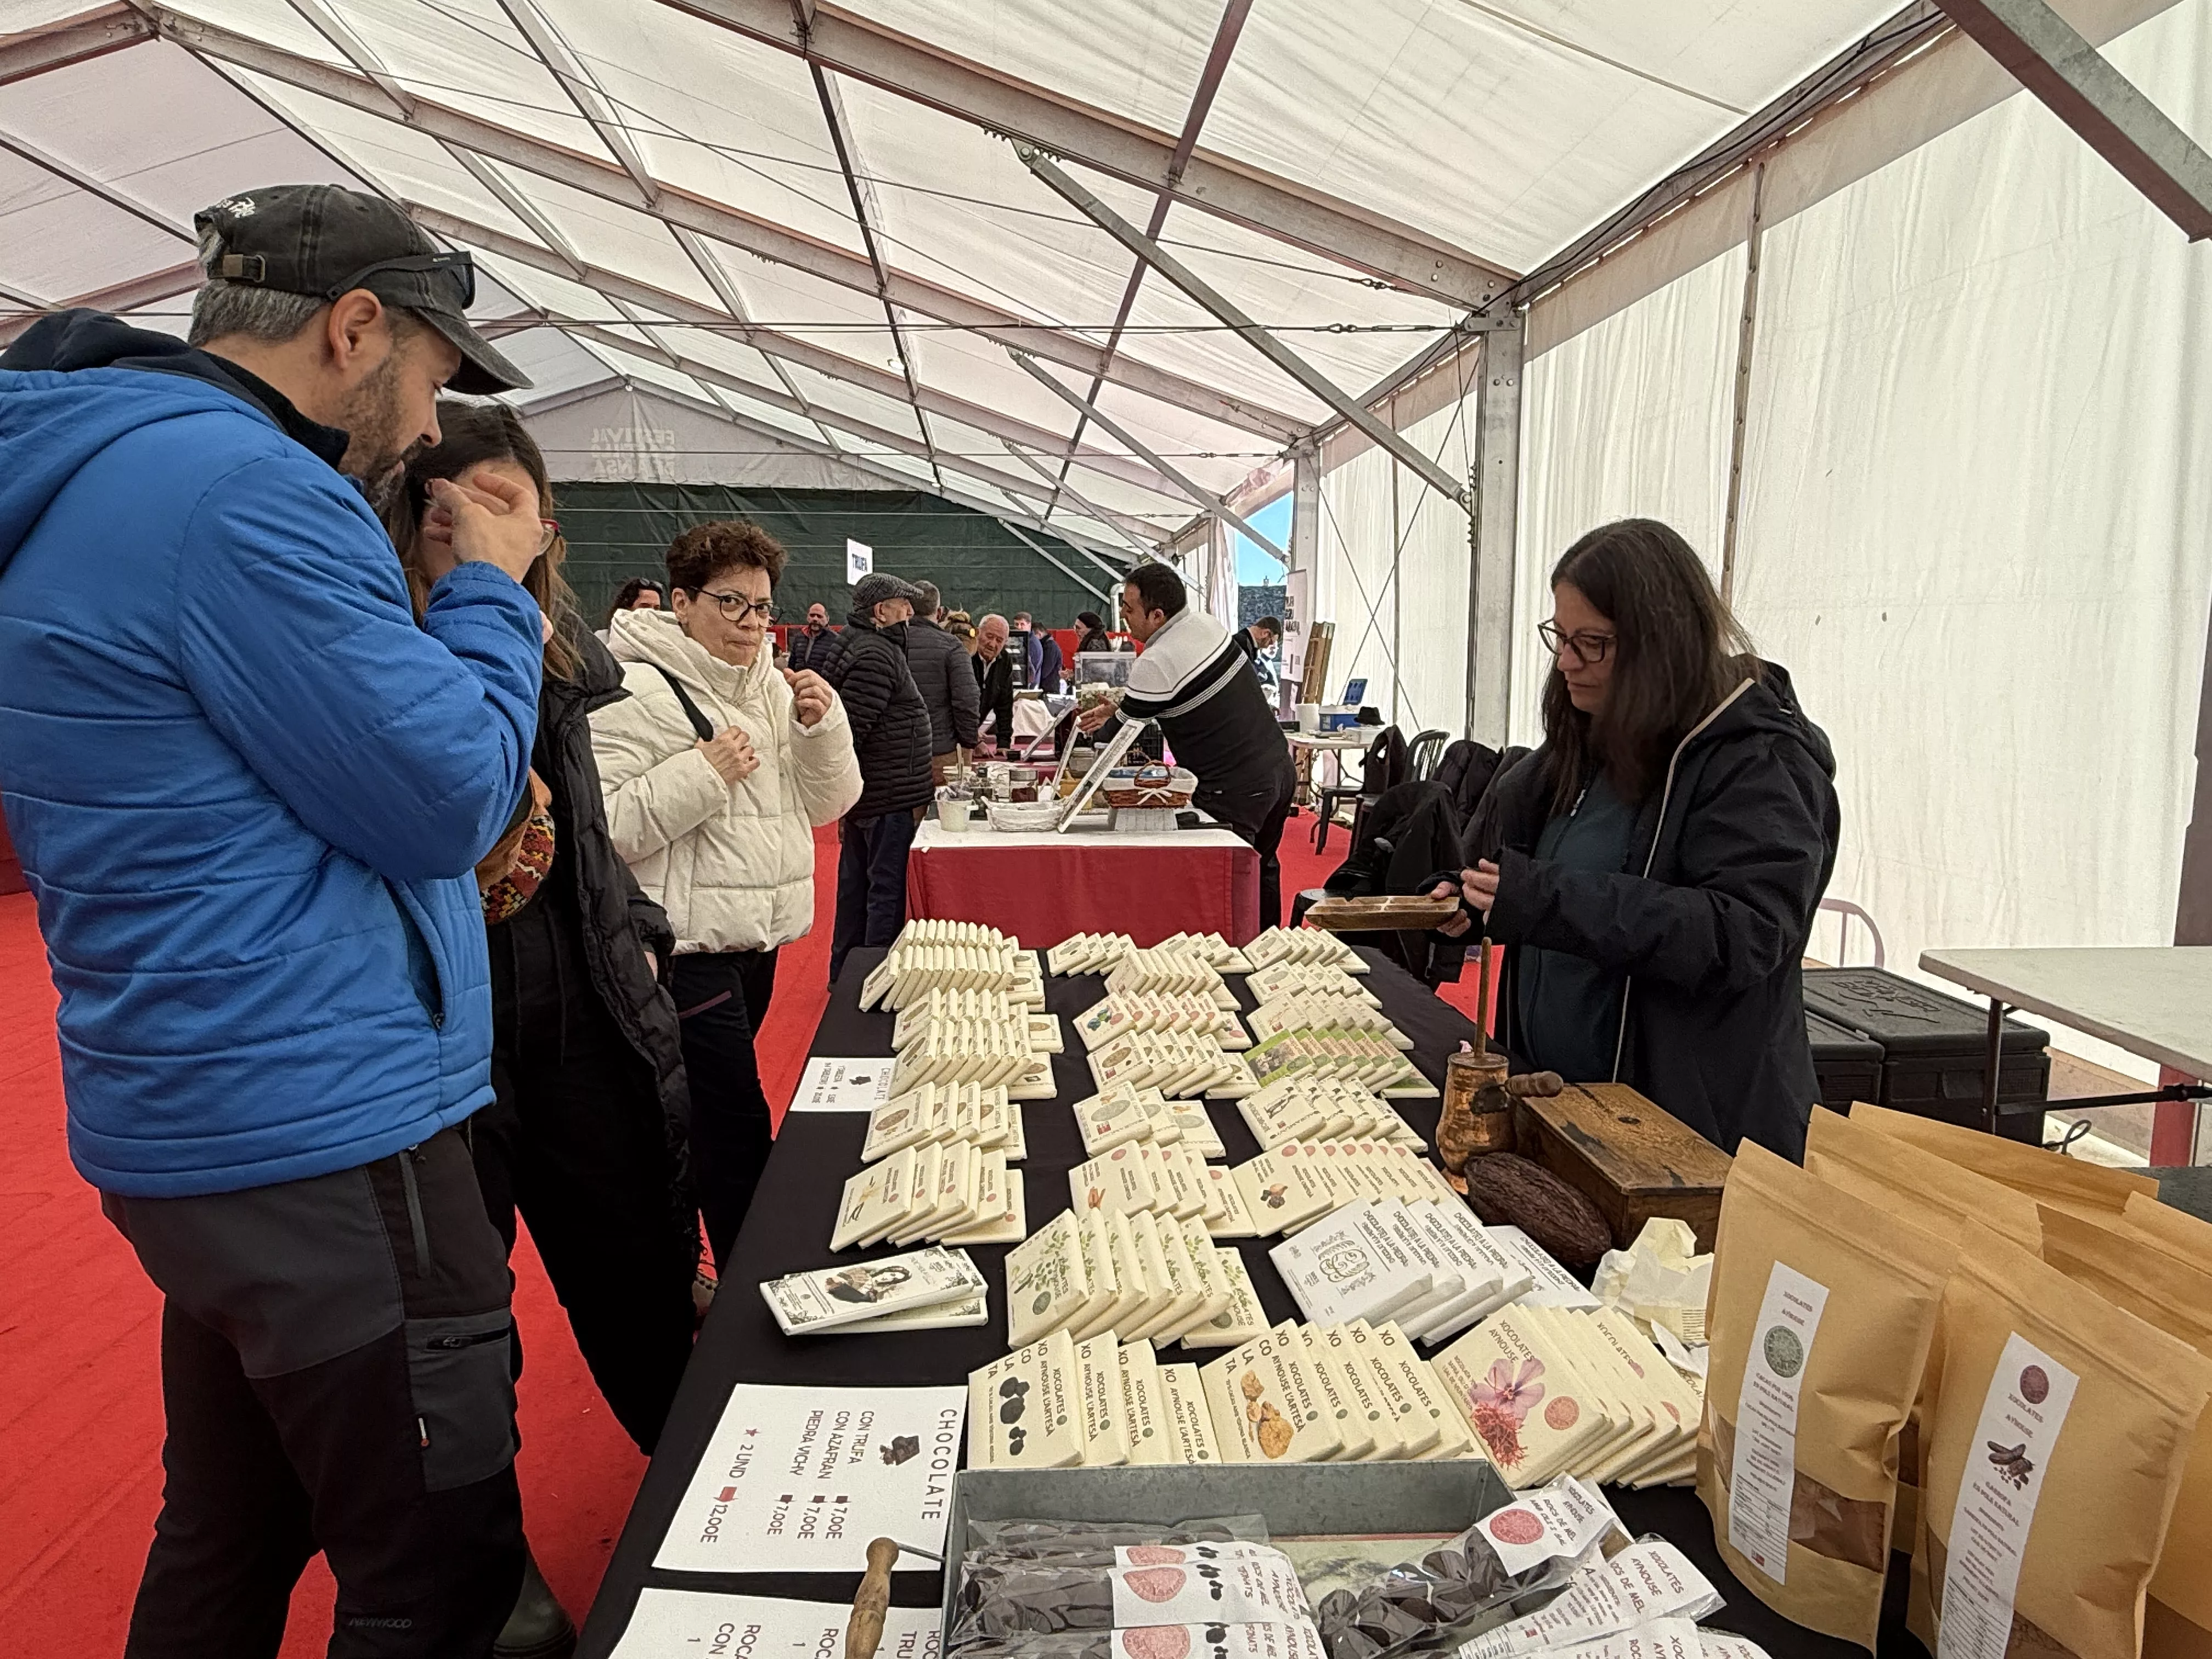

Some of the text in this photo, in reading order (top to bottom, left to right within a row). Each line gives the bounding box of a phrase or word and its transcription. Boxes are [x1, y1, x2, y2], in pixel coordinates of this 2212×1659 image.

[1037, 1340, 1048, 1356] XO
[1081, 1344, 1091, 1359] XO
[1260, 1340, 1272, 1356] CO
[1276, 1330, 1289, 1346] XO
[1327, 1330, 1342, 1347] XO
[1351, 1327, 1366, 1344] XO
[1379, 1330, 1395, 1346] XO
[1489, 1329, 1519, 1364] AYNOUSE
[1499, 1319, 1535, 1362] XOCOLATES
[988, 1363, 998, 1379] TA
[1004, 1357, 1014, 1372] LA
[1021, 1348, 1031, 1364] CO
[1118, 1349, 1128, 1365] XO
[1224, 1358, 1237, 1374] TA
[1242, 1349, 1254, 1365] LA
[1052, 1367, 1065, 1414] XOCOLATES
[1097, 1370, 1109, 1419] XOCOLATES
[1164, 1368, 1176, 1383] XO
[1272, 1356, 1306, 1432] AYNOUSE L'ARTESÀ
[1288, 1361, 1312, 1409] XOCOLATES
[1314, 1363, 1341, 1408] XOCOLATES
[1344, 1361, 1373, 1409] XOCOLATES
[1370, 1357, 1403, 1403] XOCOLATES
[1398, 1360, 1432, 1408] XOCOLATES
[1136, 1378, 1150, 1426] XOCOLATES
[1170, 1387, 1186, 1425] AYNOUSE
[1187, 1401, 1205, 1448] XOCOLATES
[729, 1453, 751, 1478] UND
[767, 1410, 823, 1535] PIEDRA VICHY 7,00E
[797, 1411, 850, 1539] CON AZAFRAN 7,00E
[825, 1411, 874, 1539] CON TRUFA 7,00E
[921, 1408, 957, 1520] CHOCOLATE
[700, 1504, 728, 1543] 12,00E
[1631, 1558, 1662, 1596] AYNOUSE
[1647, 1550, 1684, 1594] XOCOLATES
[1620, 1577, 1634, 1590] DE
[1629, 1592, 1645, 1615] MEL
[708, 1623, 735, 1655] CON
